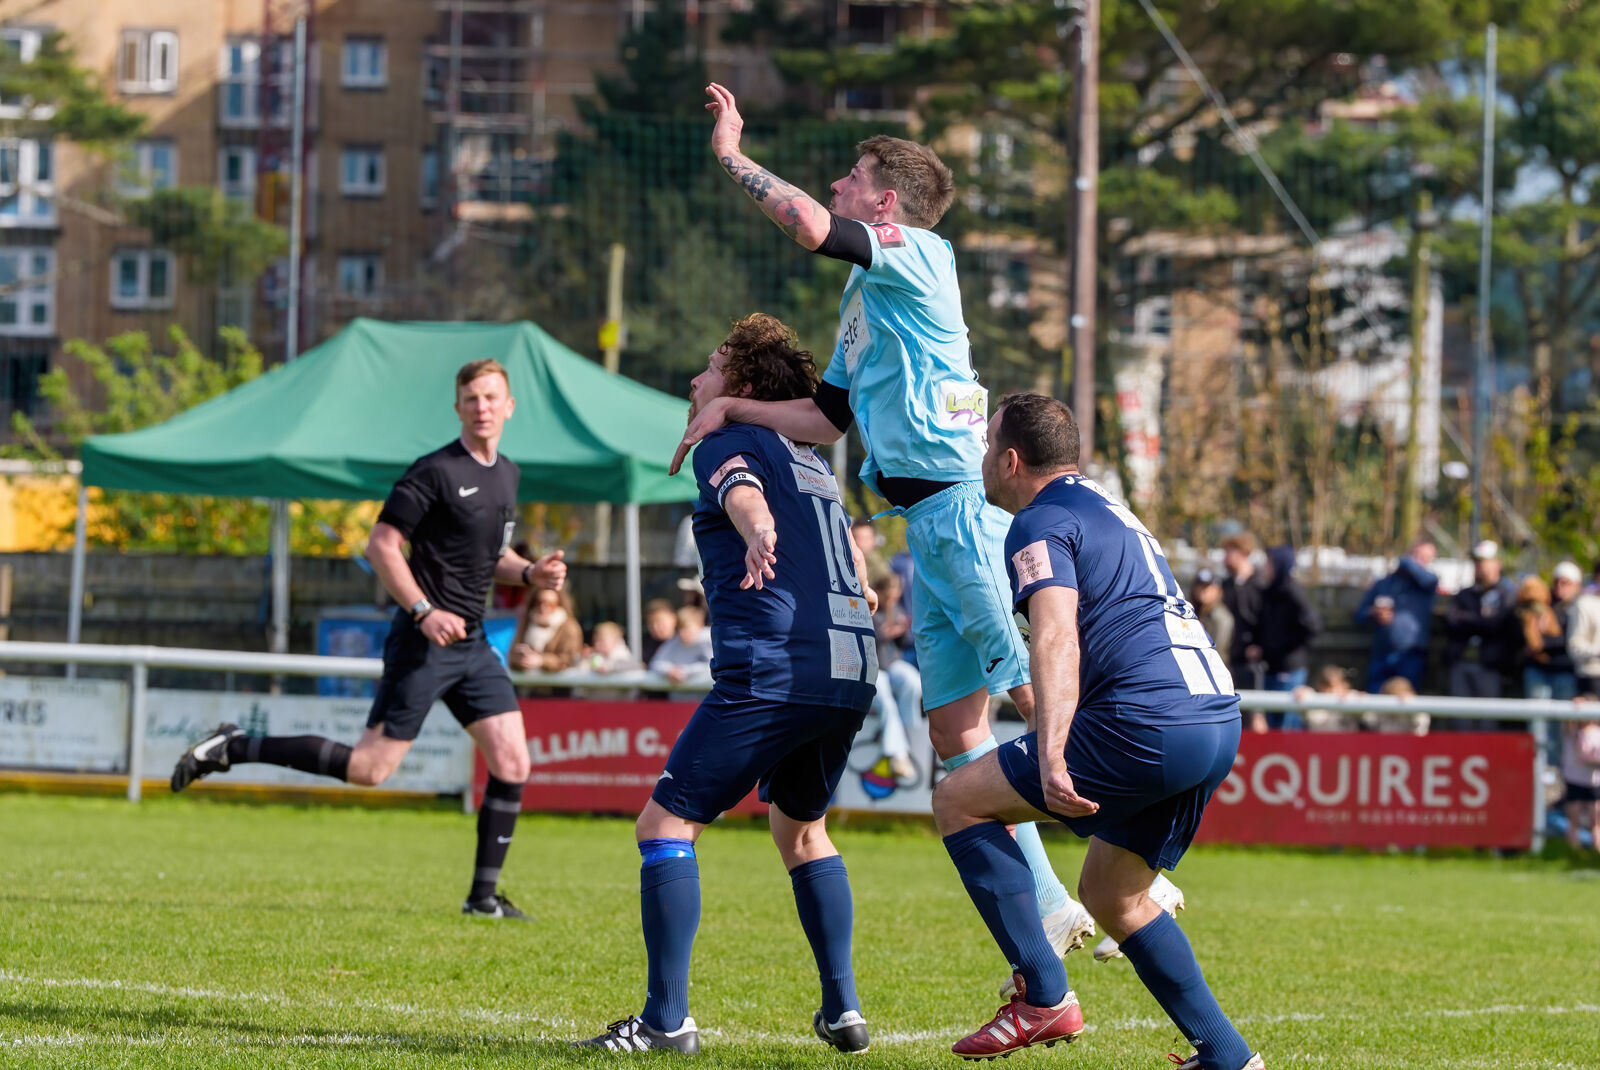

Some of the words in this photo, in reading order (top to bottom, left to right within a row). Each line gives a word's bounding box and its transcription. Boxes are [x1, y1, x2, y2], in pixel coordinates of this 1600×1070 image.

[719, 473, 747, 494] CAPTAIN
[812, 495, 864, 596] 10
[1019, 561, 1043, 577] Copper
[1025, 570, 1040, 580] Fox
[1217, 753, 1490, 809] SQUIRES
